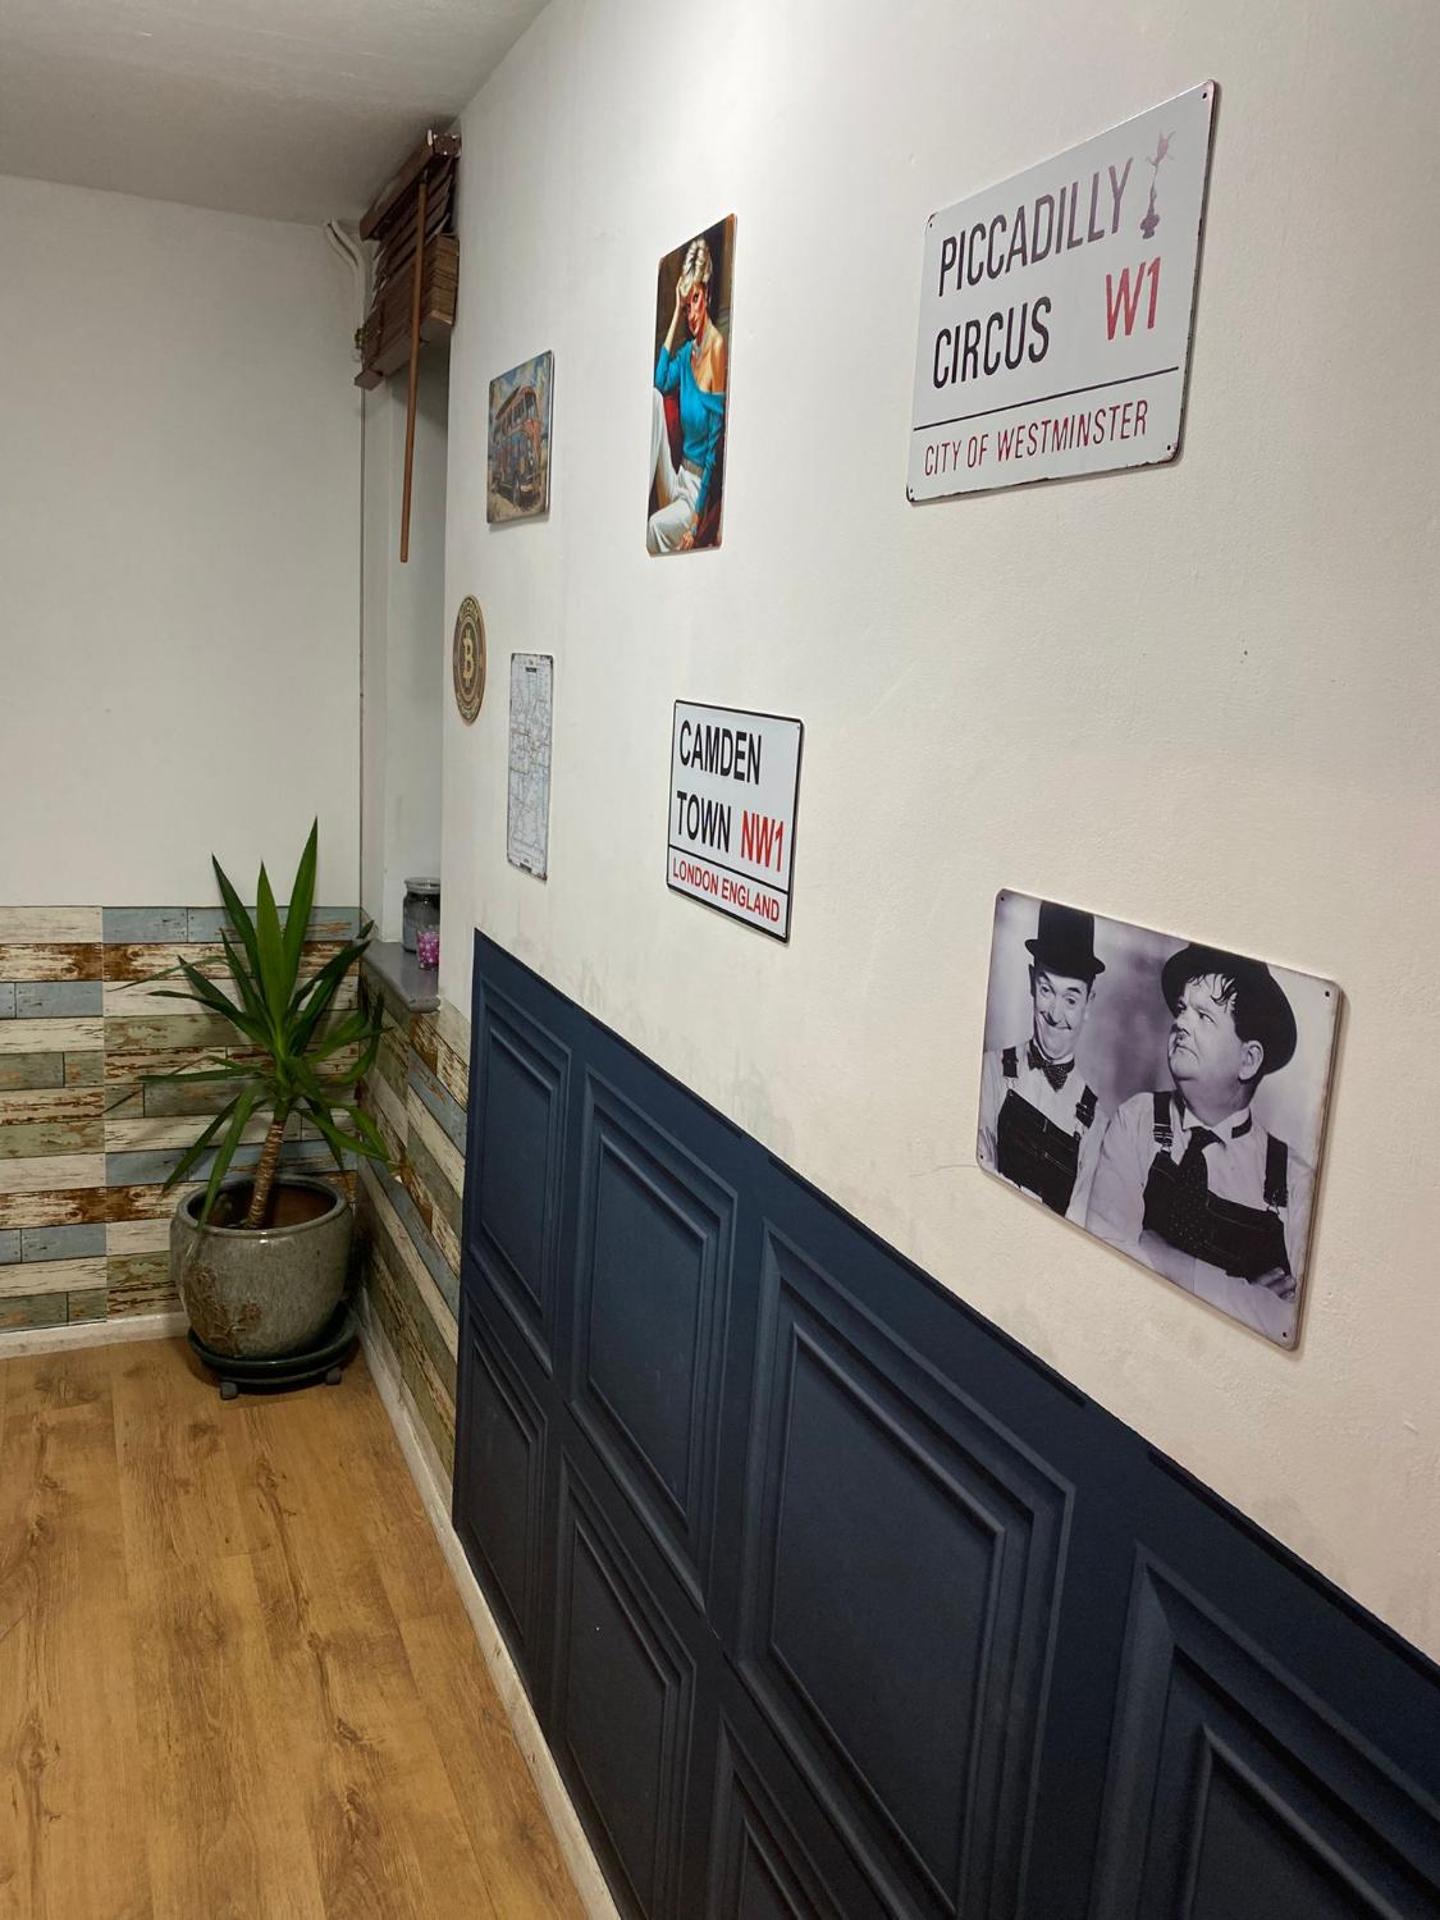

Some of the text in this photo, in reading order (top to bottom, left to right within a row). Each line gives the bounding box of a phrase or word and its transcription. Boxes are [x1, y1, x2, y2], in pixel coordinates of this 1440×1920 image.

[938, 156, 1134, 297] PICCADILLY
[932, 256, 1161, 389] CIRCUS W1
[924, 399, 1149, 477] CITY OF WESTMINSTER
[679, 719, 762, 785] CAMDEN
[676, 790, 784, 873] TOWN NW1
[672, 857, 781, 923] LONDON ENGLAND
